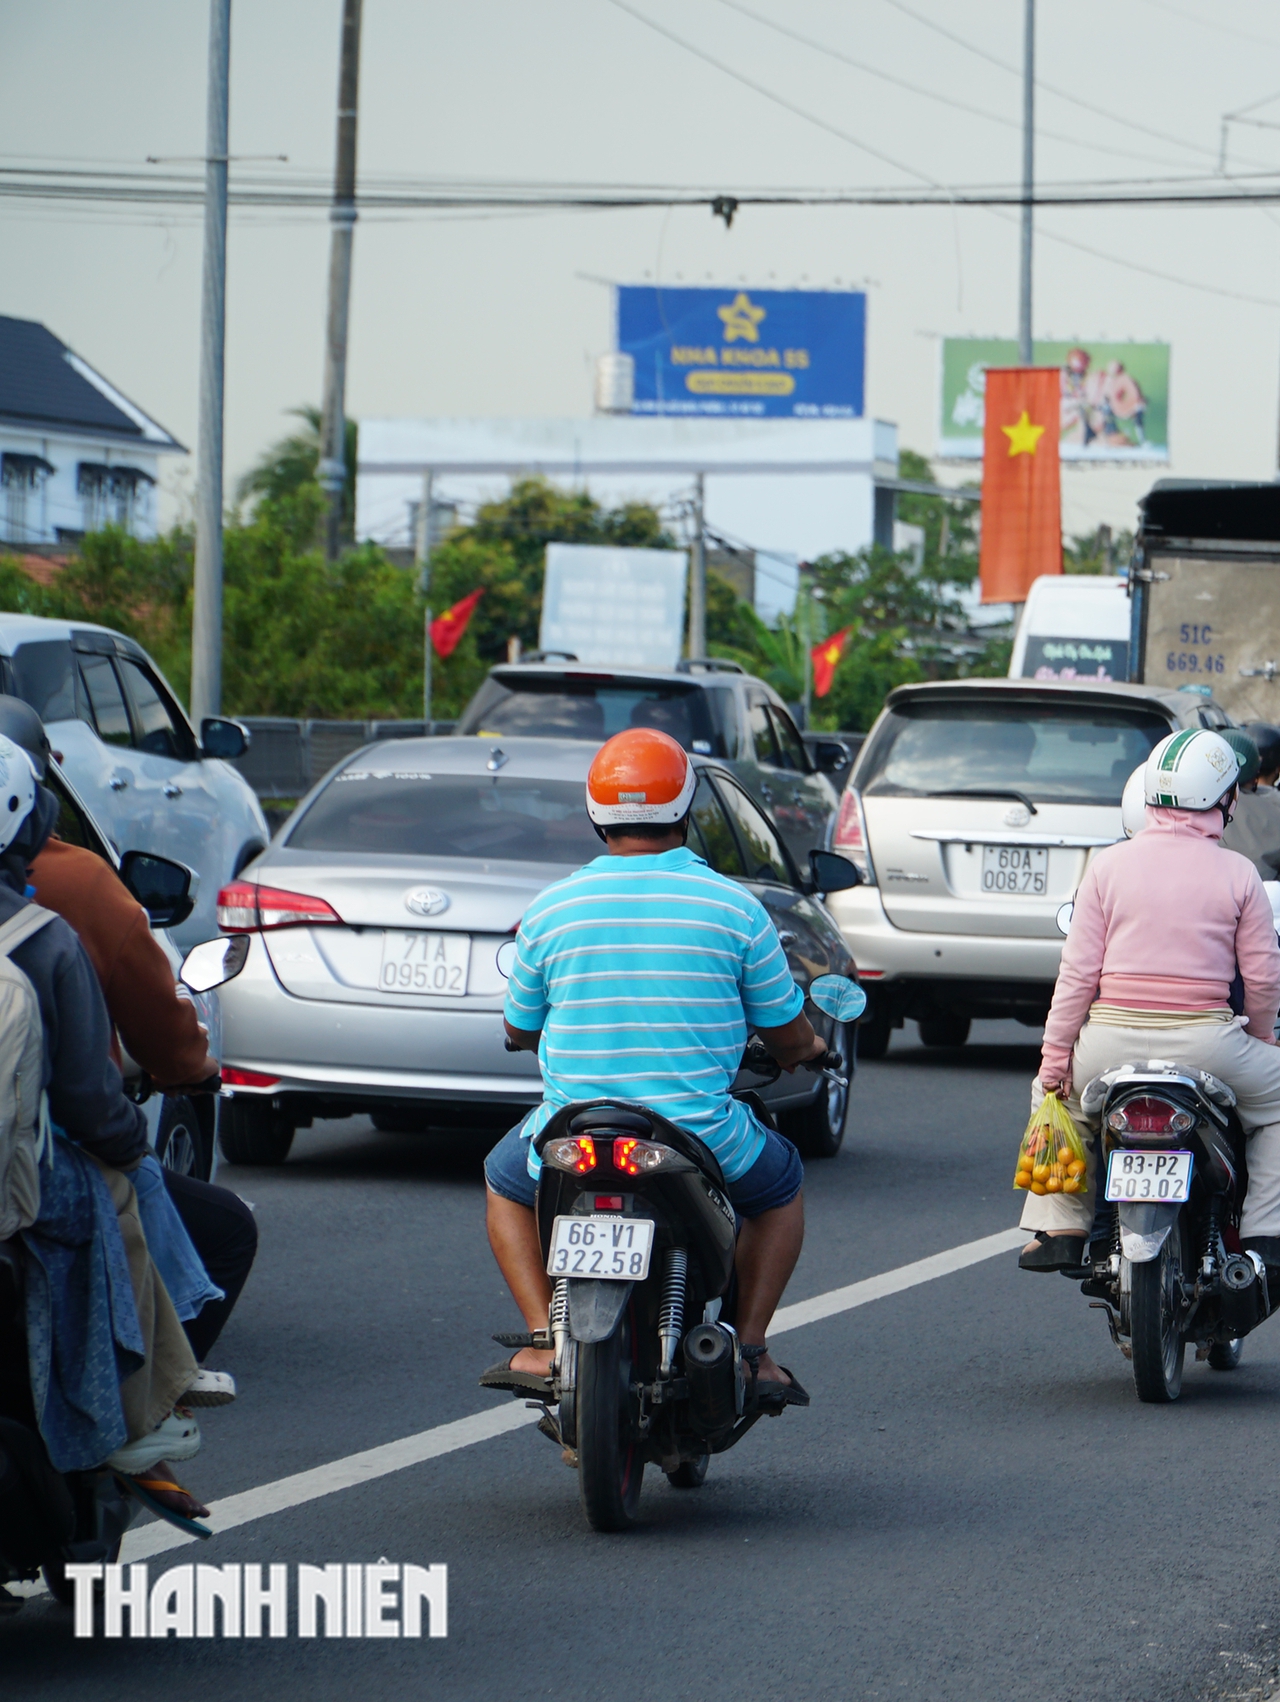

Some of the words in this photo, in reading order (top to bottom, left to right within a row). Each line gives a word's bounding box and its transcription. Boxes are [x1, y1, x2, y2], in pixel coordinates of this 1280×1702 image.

[1180, 624, 1213, 645] 51C
[1166, 652, 1226, 674] 669.46
[999, 849, 1031, 869] 60A
[984, 870, 1045, 892] 008.75
[403, 934, 447, 962] 71A
[383, 962, 463, 991] 095.02
[1122, 1155, 1179, 1176] 83-P2
[1111, 1178, 1184, 1199] 503.02
[568, 1222, 635, 1248] 66-V1
[555, 1248, 643, 1275] 322.58
